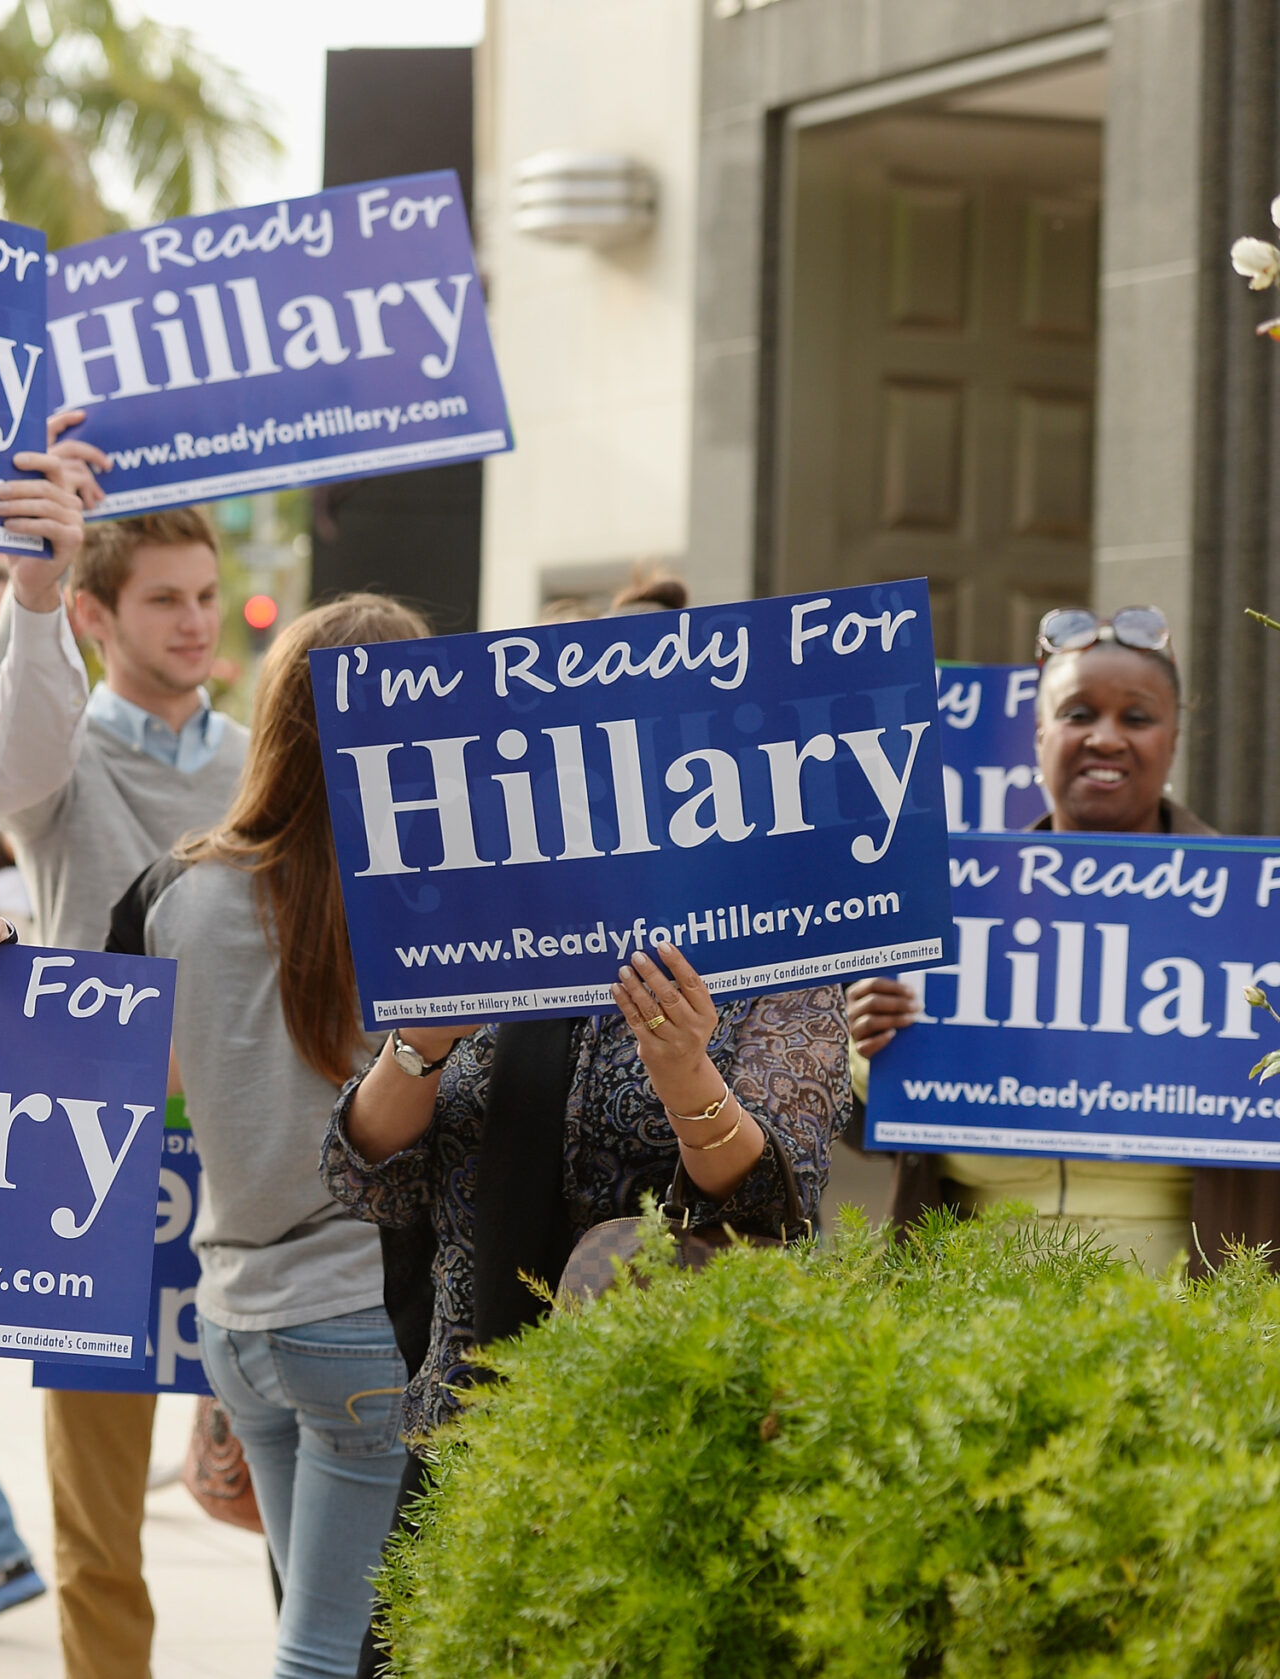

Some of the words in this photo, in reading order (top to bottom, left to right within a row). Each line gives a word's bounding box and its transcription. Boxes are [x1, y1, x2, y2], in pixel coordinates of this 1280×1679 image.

[46, 253, 128, 294] 'm
[141, 202, 334, 275] Ready
[358, 187, 454, 239] For
[46, 273, 474, 414] Hillary
[335, 646, 464, 713] I'm
[487, 612, 749, 694] Ready
[790, 597, 917, 666] For
[336, 718, 931, 878] Hillary
[1019, 846, 1229, 918] Ready
[394, 891, 901, 969] www.ReadyforHillary.com
[703, 974, 738, 992] horized
[740, 973, 752, 988] by
[754, 970, 771, 984] any
[773, 964, 820, 980] Candidate
[822, 961, 832, 973] or
[835, 951, 888, 971] Candidate's
[890, 945, 940, 962] Committee
[24, 955, 160, 1026] For
[377, 1003, 398, 1017] Paid
[400, 1004, 414, 1016] for
[416, 1003, 427, 1017] by
[430, 1001, 458, 1015] Ready
[460, 999, 476, 1012] For
[478, 996, 510, 1012] Hillary
[512, 994, 530, 1008] PAC
[898, 917, 1280, 1040] Hillar
[1, 1331, 13, 1344] or
[15, 1332, 73, 1350] Candidate's
[76, 1337, 130, 1355] Committee
